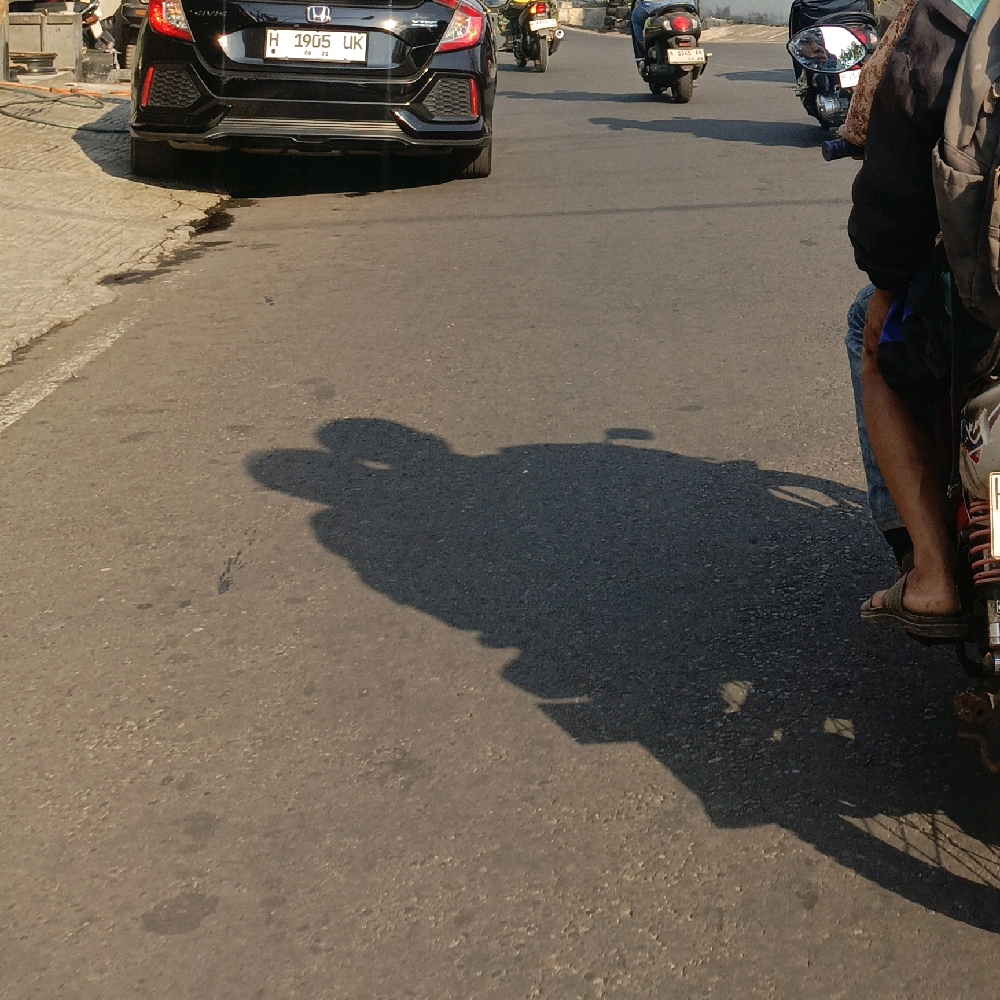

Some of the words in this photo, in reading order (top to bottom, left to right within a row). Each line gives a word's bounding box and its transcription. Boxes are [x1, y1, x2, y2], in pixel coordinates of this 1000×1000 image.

[269, 32, 279, 47] H
[294, 33, 331, 49] 1905
[343, 35, 364, 50] UK
